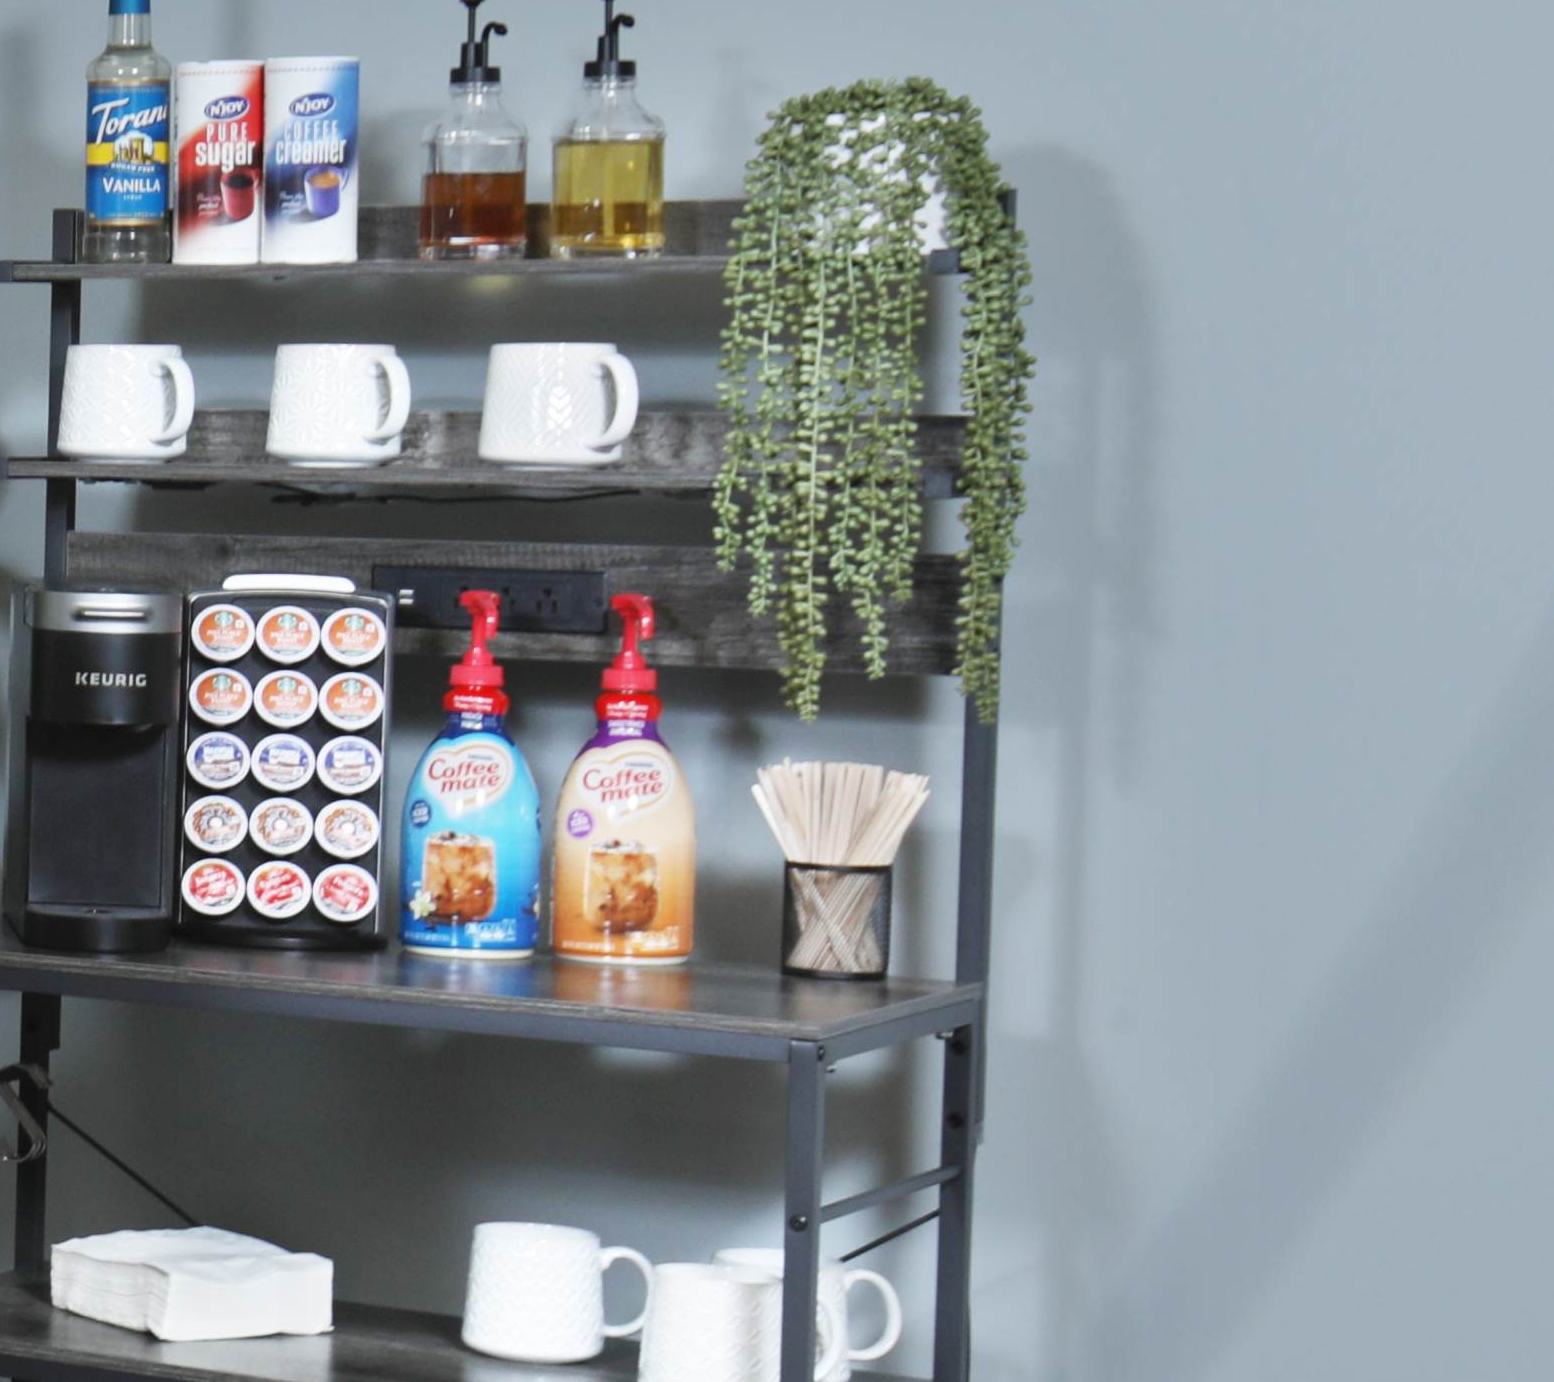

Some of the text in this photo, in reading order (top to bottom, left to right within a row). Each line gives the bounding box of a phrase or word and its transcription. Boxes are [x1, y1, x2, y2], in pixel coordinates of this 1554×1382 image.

[206, 122, 249, 142] PURE
[284, 120, 339, 140] COFFEE
[195, 138, 256, 173] sugar
[275, 138, 347, 165] creamer
[102, 176, 161, 194] VANILLA
[75, 671, 147, 688] KEURIG
[428, 758, 501, 781] Coffee
[582, 768, 661, 791] Coffee
[440, 774, 501, 794] mate
[601, 780, 664, 804] mate
